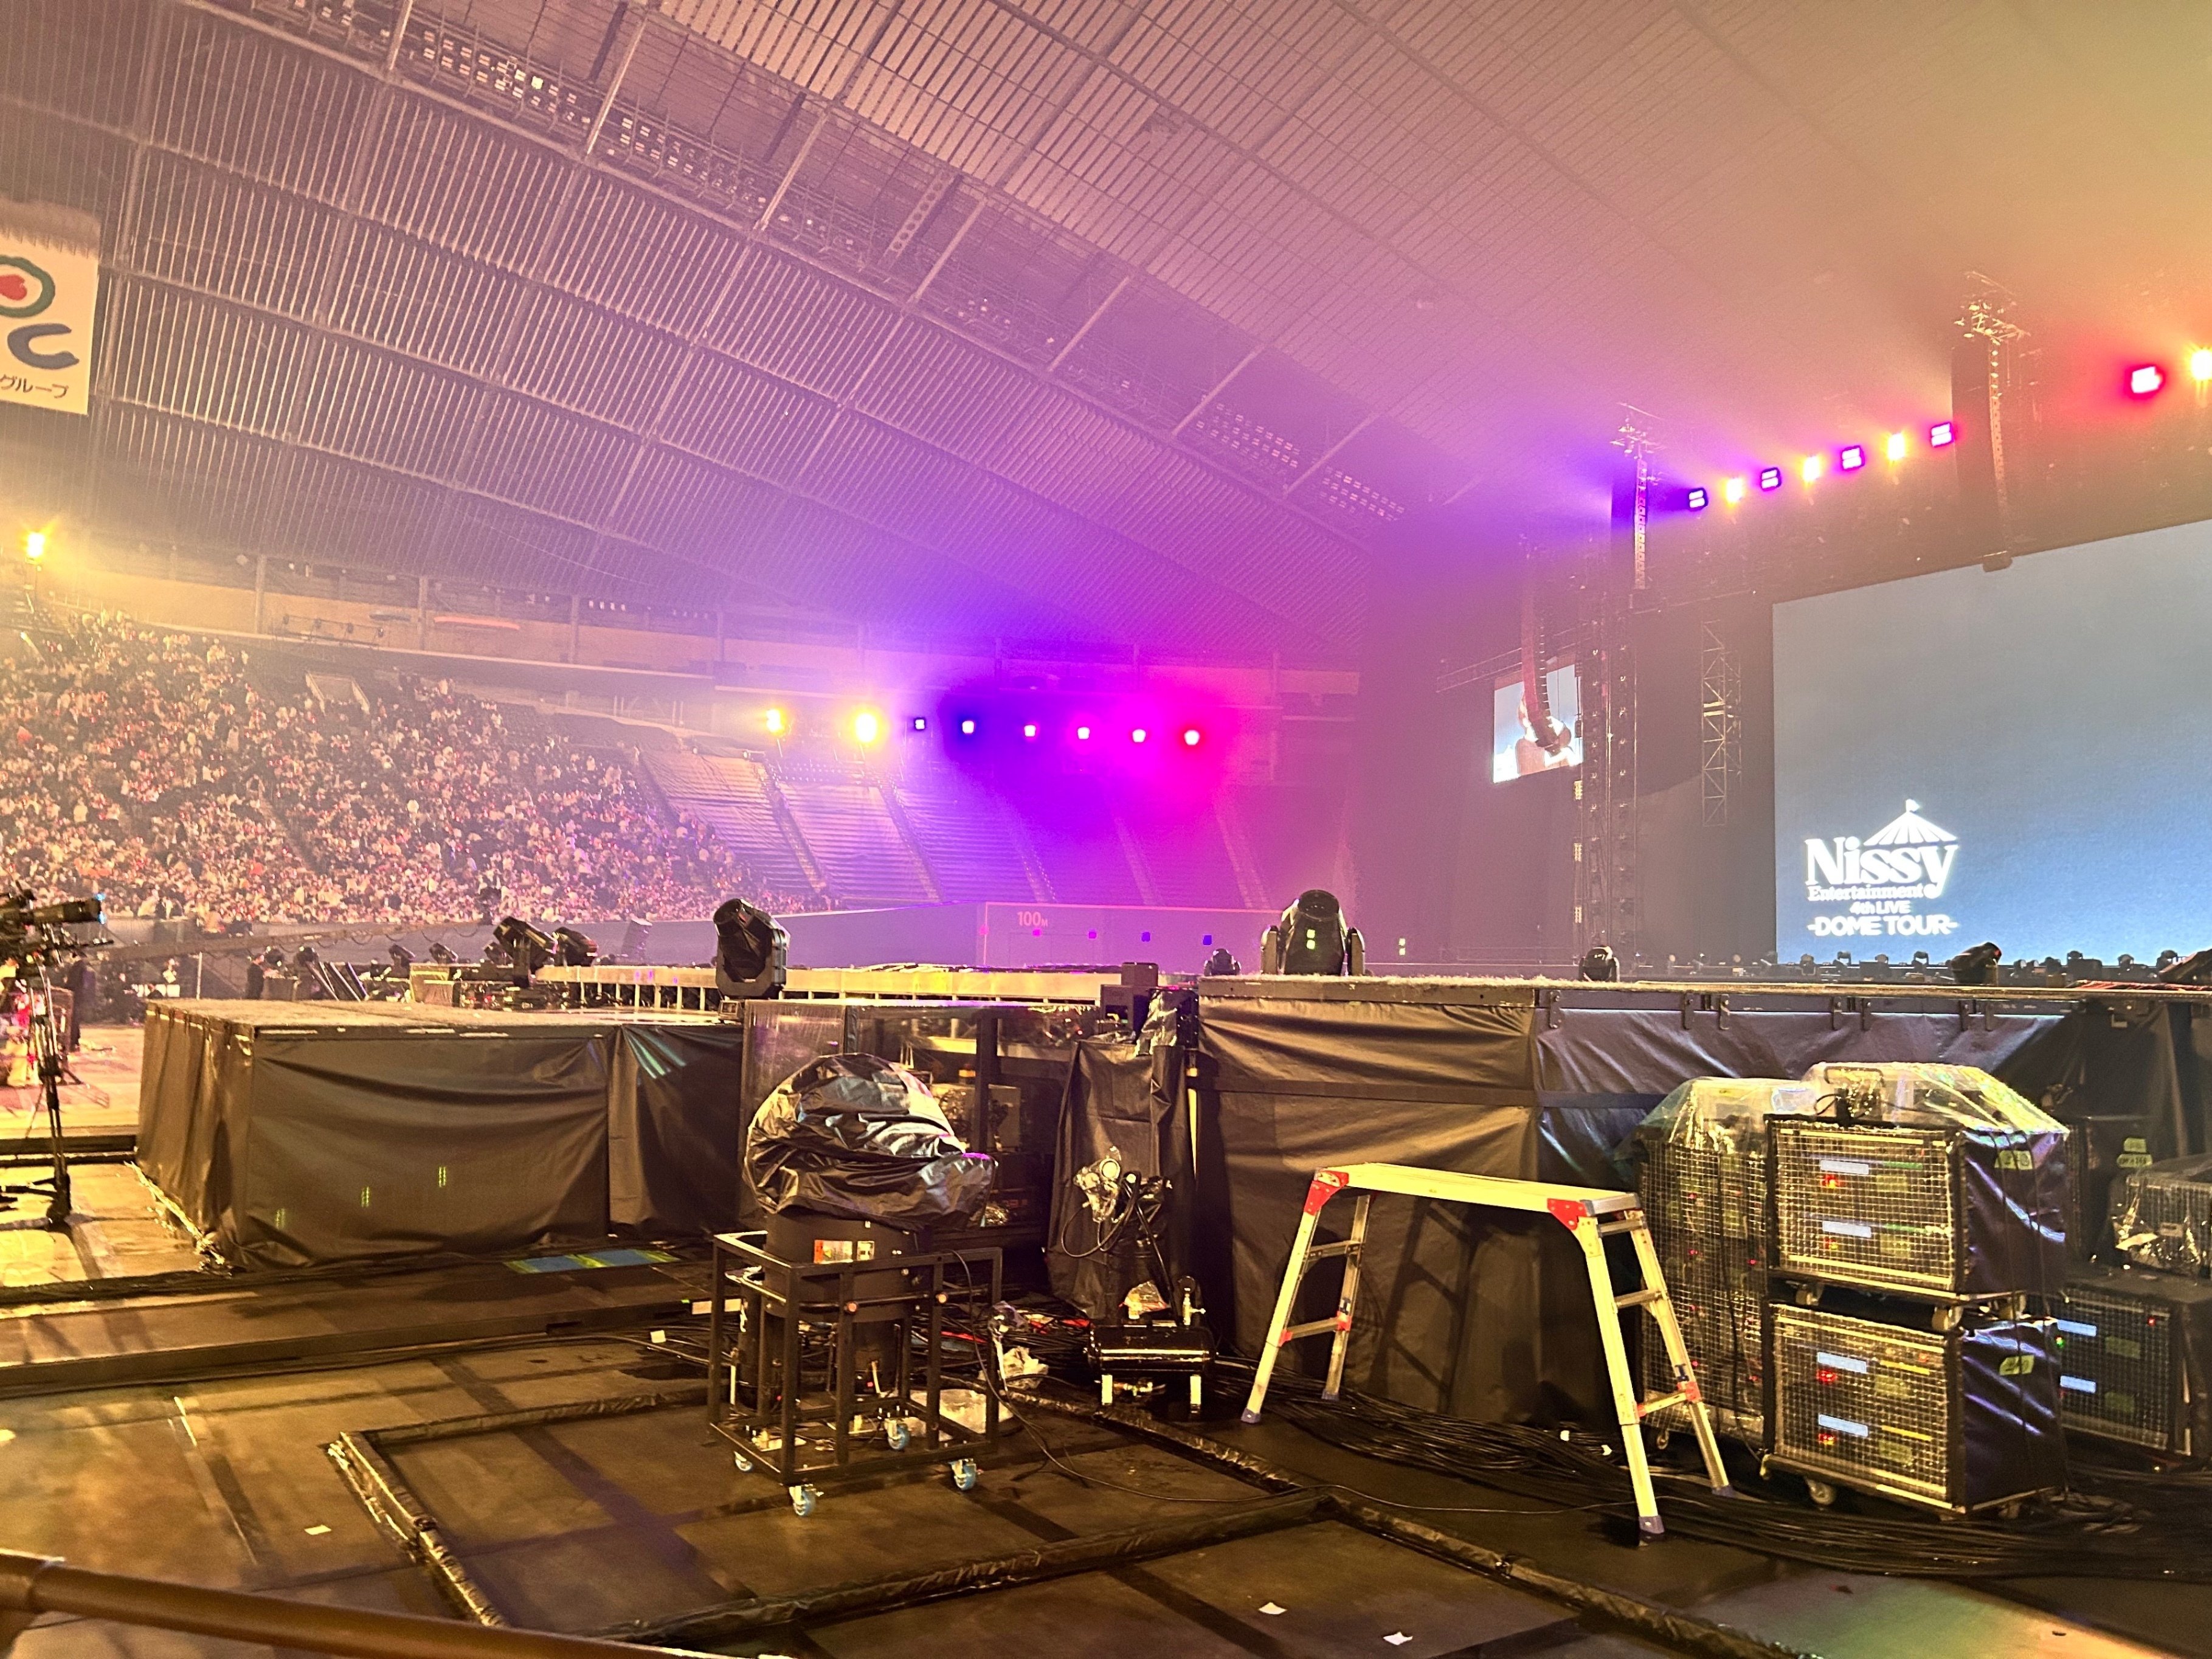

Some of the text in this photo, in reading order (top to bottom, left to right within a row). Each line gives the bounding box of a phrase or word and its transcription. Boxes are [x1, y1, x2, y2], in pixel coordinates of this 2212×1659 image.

[1805, 836, 1958, 899] Nissy
[1808, 884, 1924, 901] Entertainment
[1876, 900, 1911, 914] LIVE
